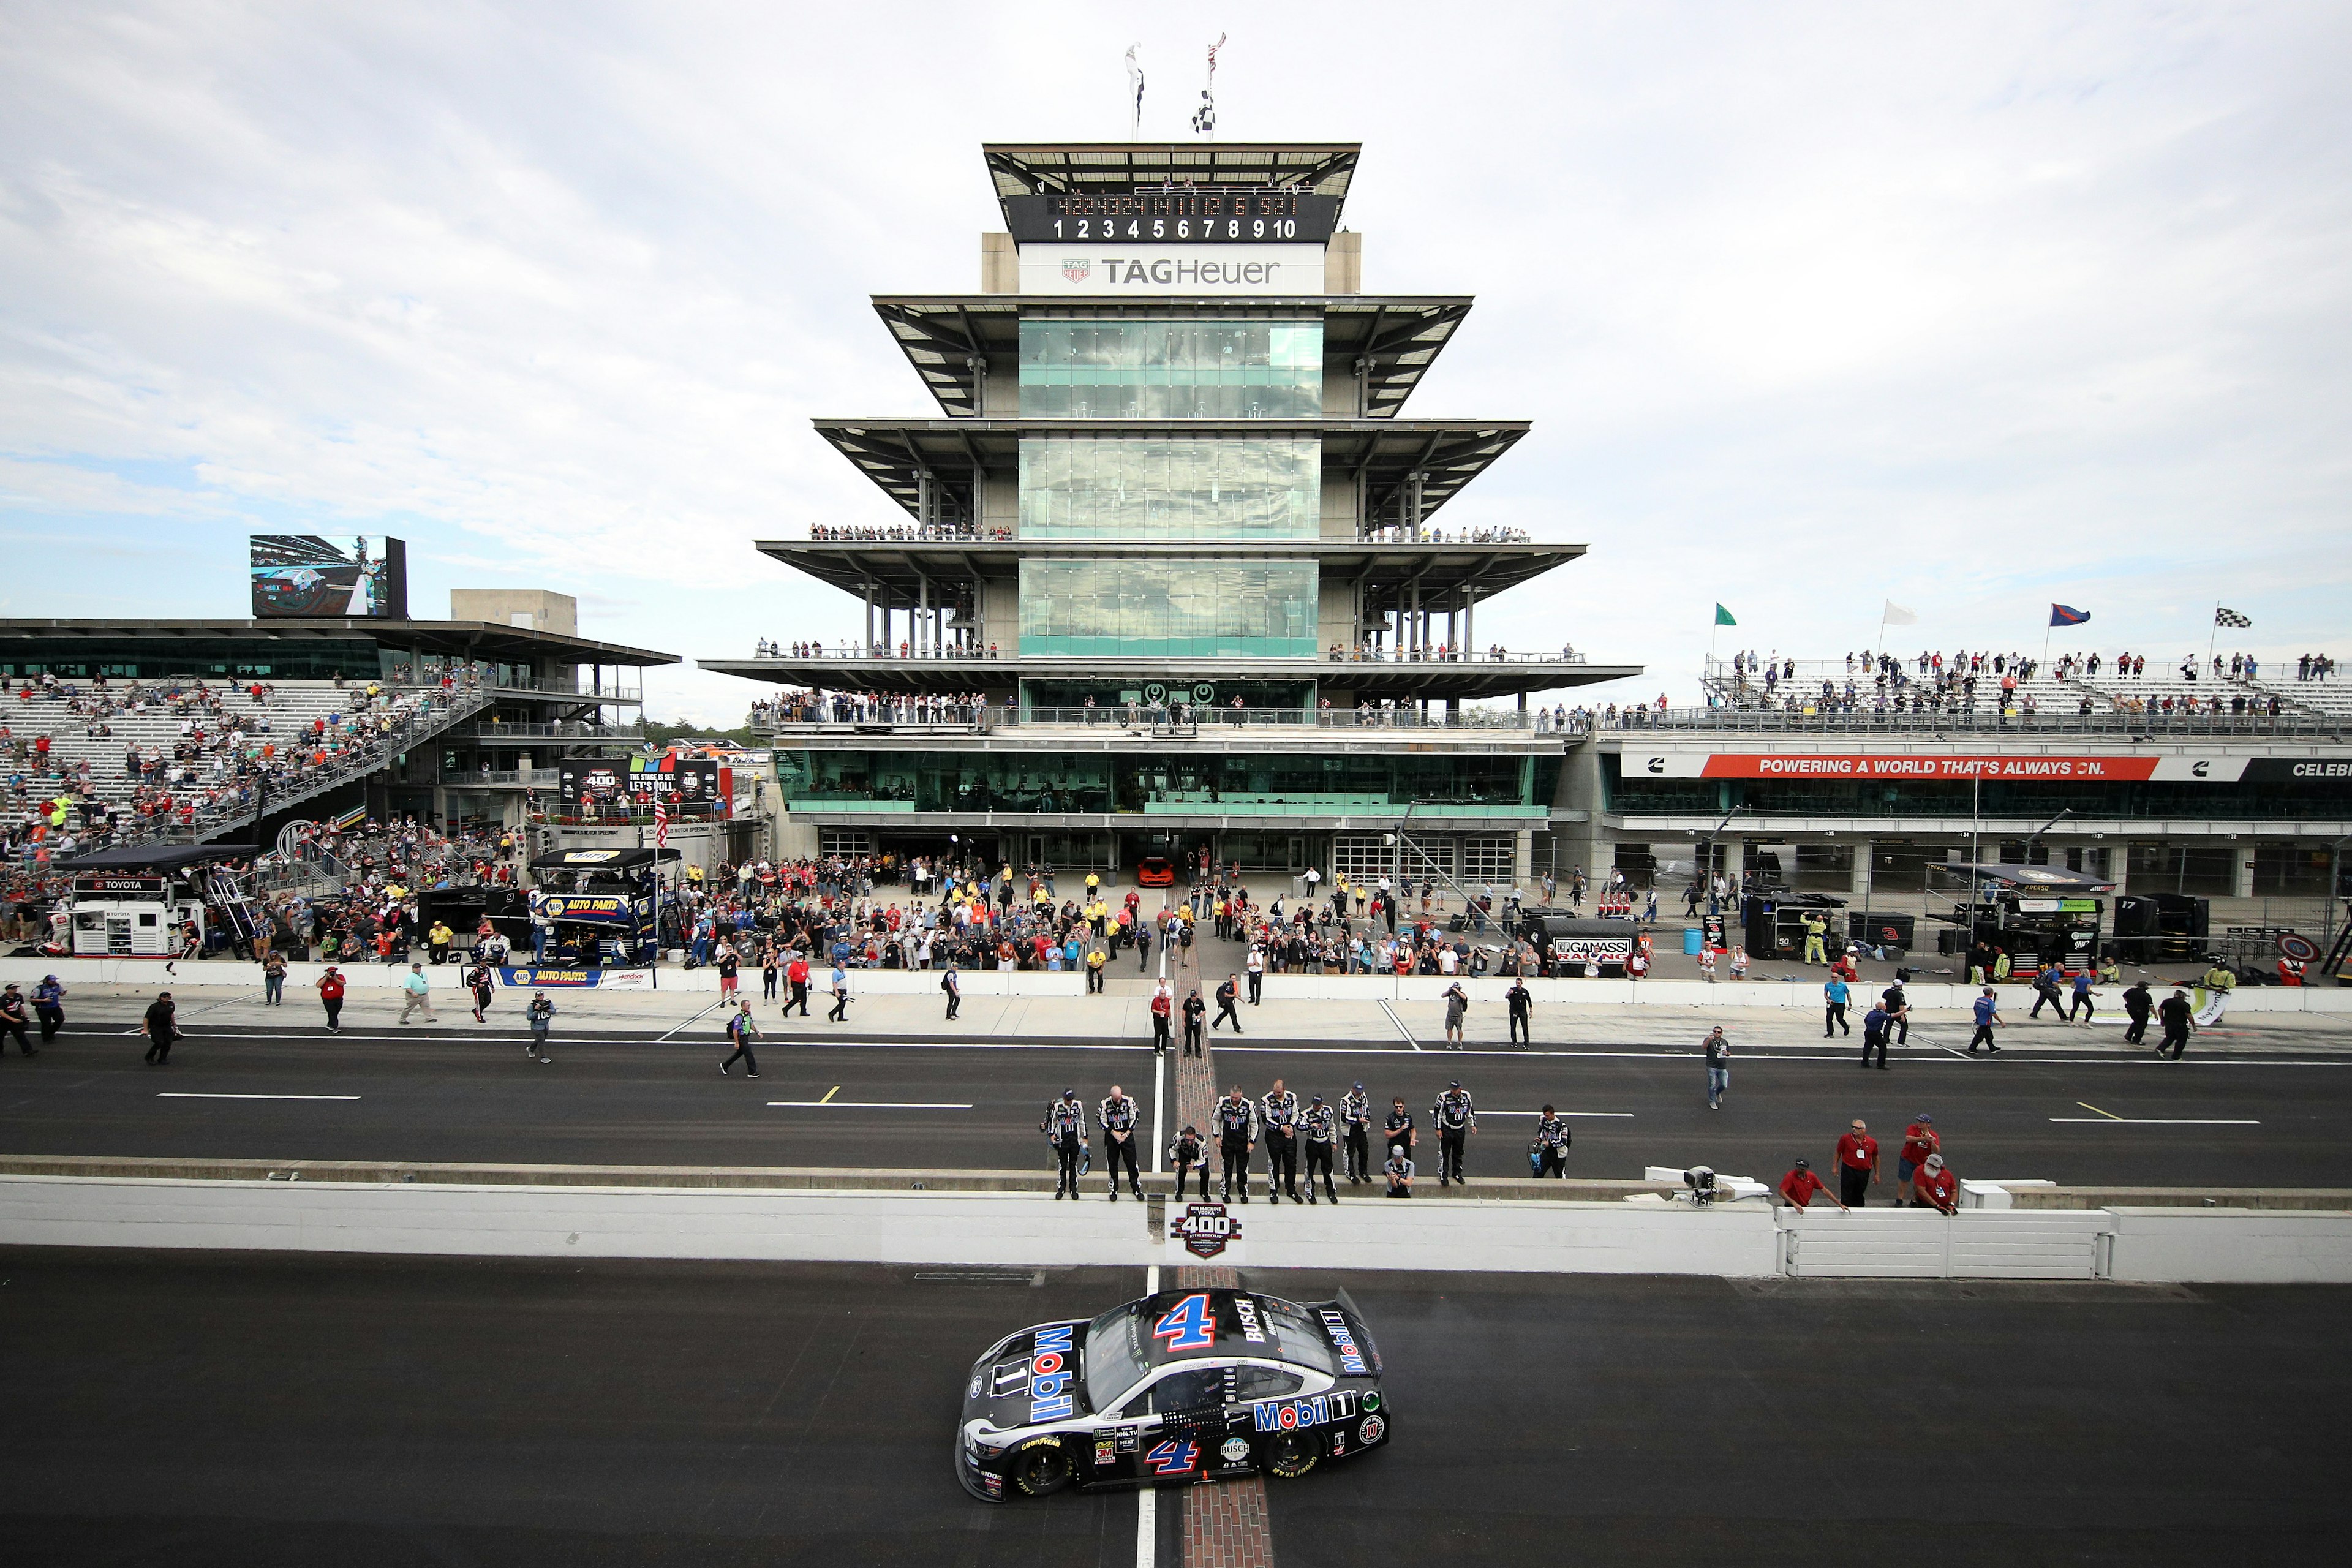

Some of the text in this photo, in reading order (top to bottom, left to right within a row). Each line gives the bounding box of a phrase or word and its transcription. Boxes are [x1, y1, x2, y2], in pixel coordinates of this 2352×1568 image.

[1058, 198, 1295, 215] 4 22 43 24 14 11 12 6 5 21
[1054, 220, 1296, 238] 1 2 3 4 5 6 7 8 9 10
[1063, 270, 1088, 282] HEUER
[1759, 760, 2105, 775] POWERING A WORLD THAT'S ALWAYS ON.
[586, 775, 616, 785] 400
[630, 780, 652, 791] LET'S
[683, 777, 698, 786] 400
[506, 893, 514, 903] 9
[566, 899, 619, 910] AUTO PARTS
[2121, 900, 2136, 909] 17
[545, 926, 555, 936] 9
[1882, 927, 1899, 940] 3
[1558, 942, 1627, 953] CHIP GANASSI
[535, 970, 587, 981] AUTO PARTS
[1224, 1113, 1246, 1124] Mobil
[1181, 1216, 1231, 1235] 400
[1152, 1293, 1216, 1353] 4
[1234, 1297, 1267, 1344] BUSCH
[1261, 1309, 1278, 1336] HARVICK
[1130, 1324, 1139, 1350] MONSTER
[1327, 1325, 1367, 1373] Mobil
[995, 1366, 1027, 1385] 1
[1030, 1325, 1074, 1423] Mobil
[971, 1378, 981, 1395] Ford
[1336, 1393, 1347, 1417] 1
[1253, 1395, 1329, 1431] Mobil
[1366, 1423, 1378, 1439] JJ
[1021, 1437, 1061, 1451] GOODYEAR
[1221, 1444, 1250, 1455] BUSCH
[1097, 1449, 1112, 1457] 3M
[1272, 1455, 1317, 1479] GOODYEAR
[980, 1471, 1003, 1481] MOOG
[1017, 1476, 1035, 1496] EAGLE
